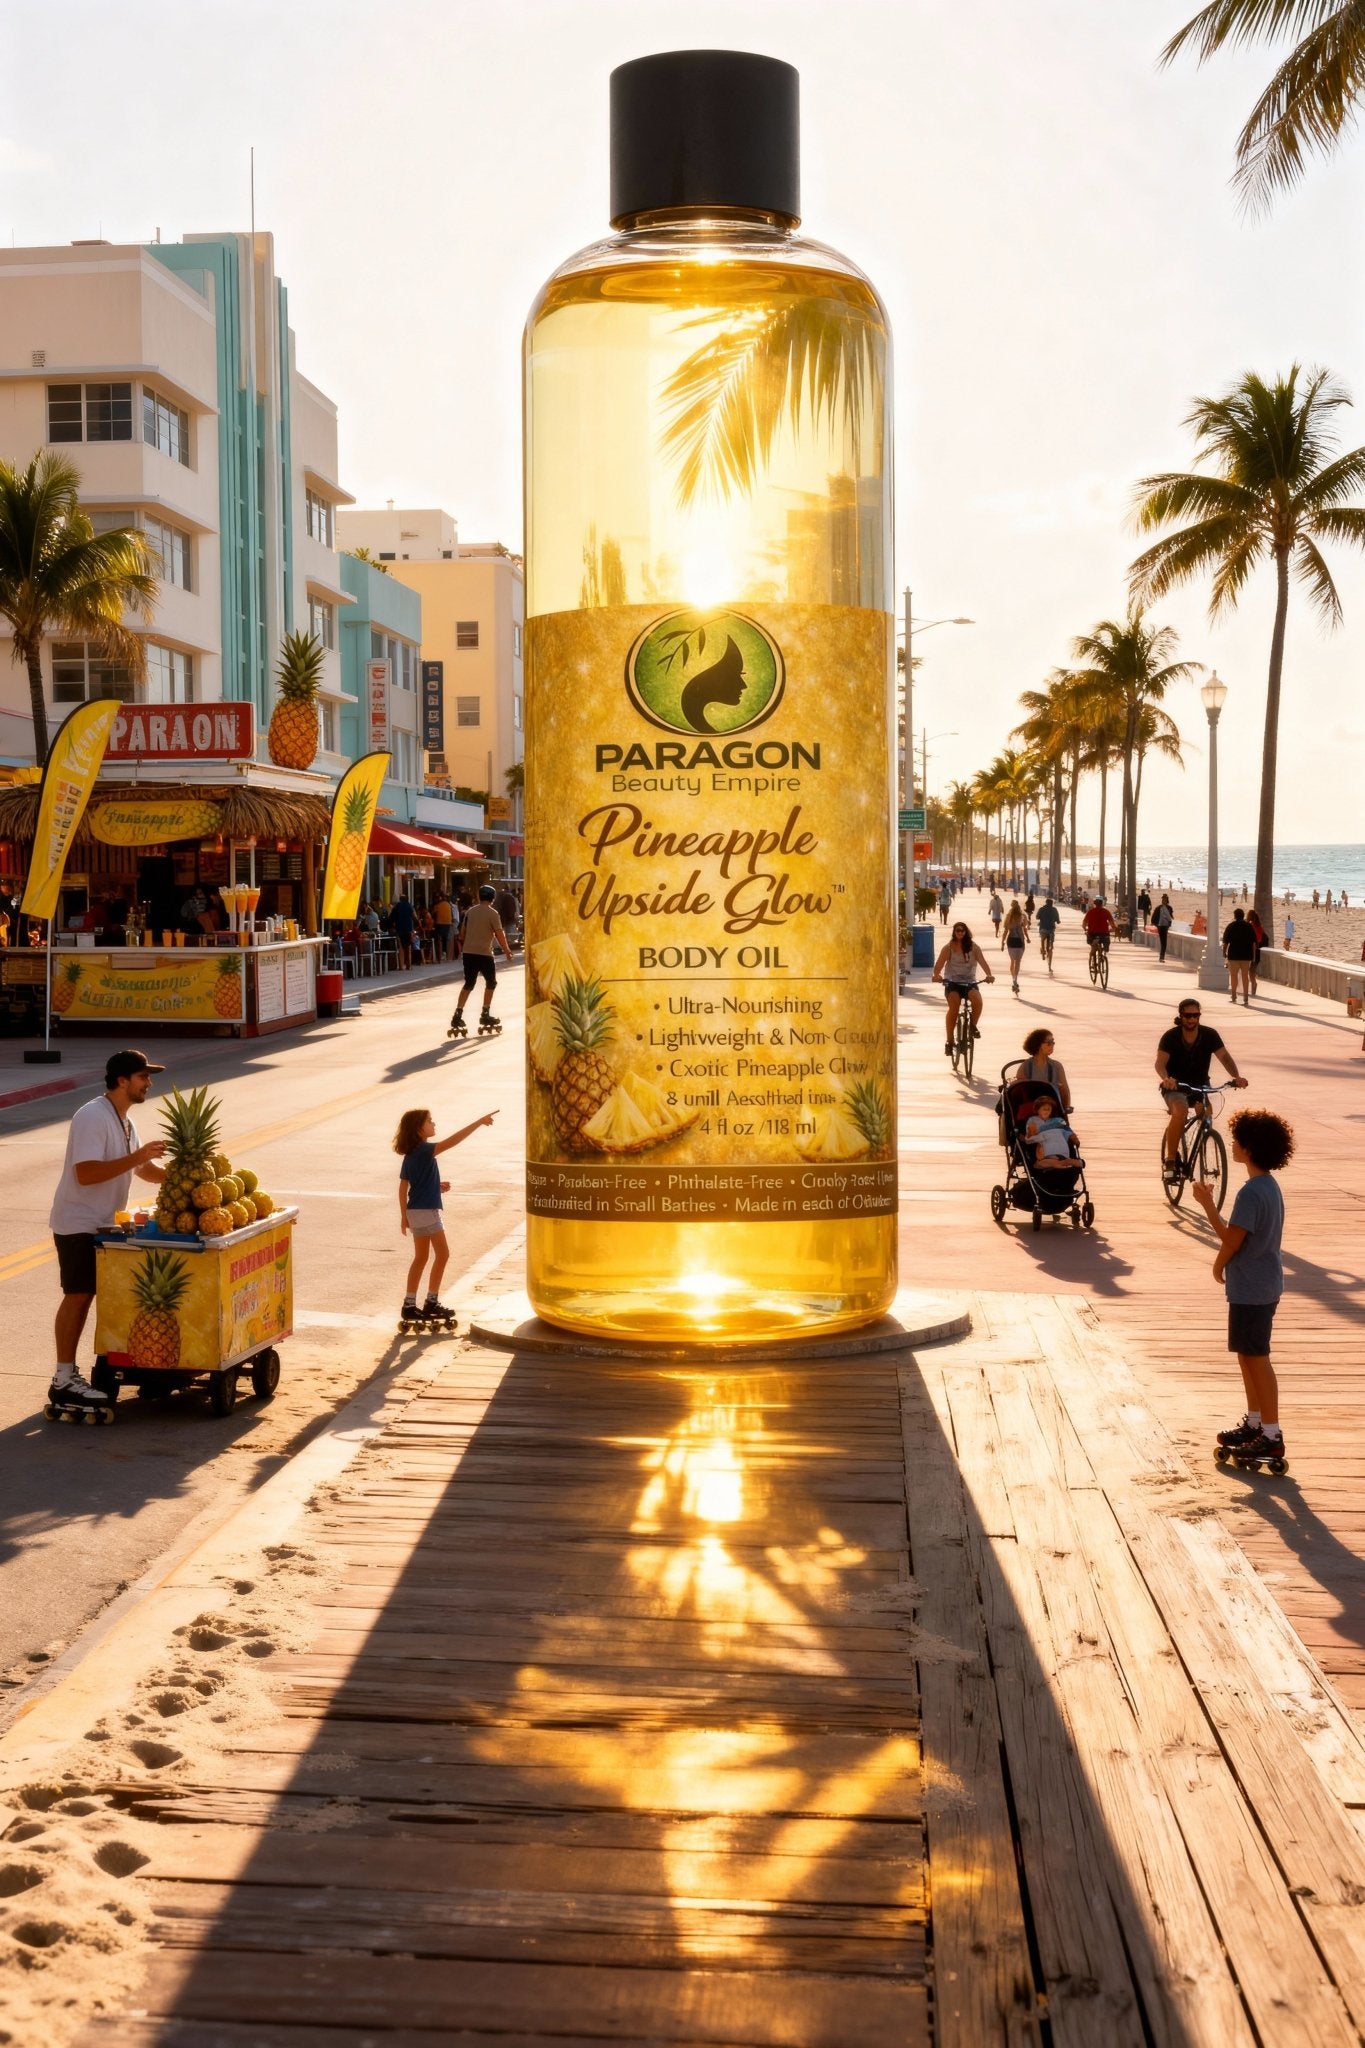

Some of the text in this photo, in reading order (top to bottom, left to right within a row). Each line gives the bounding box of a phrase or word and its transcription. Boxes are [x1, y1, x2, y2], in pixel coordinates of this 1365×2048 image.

[595, 741, 821, 772] PARAGON
[612, 773, 801, 796] Beauty Empire
[578, 802, 819, 879] Pineapple
[571, 869, 716, 935] Upside
[638, 946, 789, 969] BODY OIL
[668, 996, 823, 1020] Ultra-Nourishing
[769, 1028, 784, 1046] &
[700, 1119, 711, 1135] 4
[717, 1118, 728, 1135] fl
[733, 1123, 754, 1136] oz
[795, 1117, 816, 1135] ml
[596, 1196, 610, 1212] in
[614, 1196, 656, 1212] Small
[735, 1196, 779, 1212] Made
[782, 1197, 797, 1211] in
